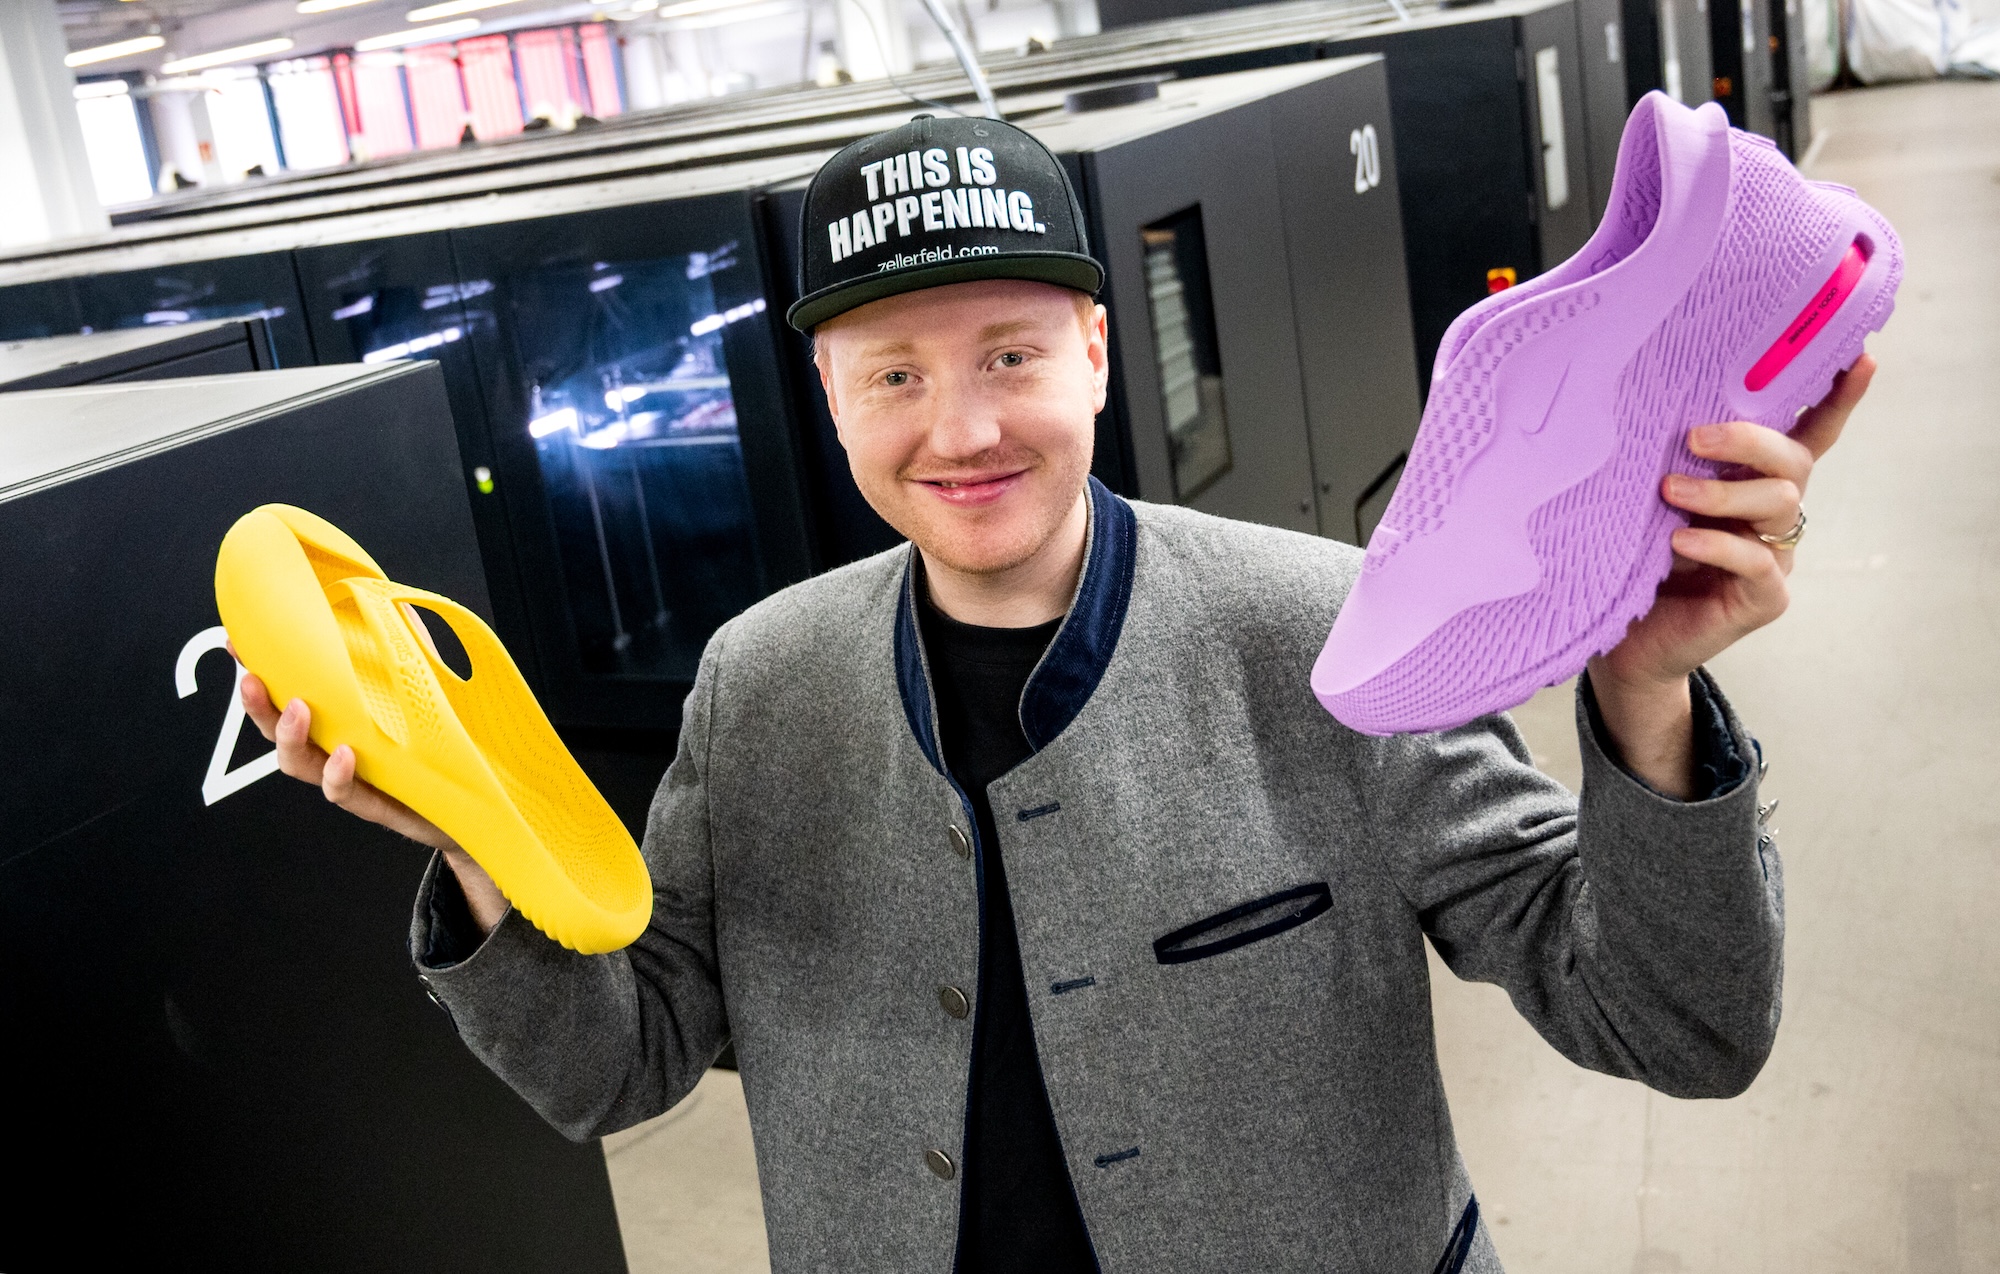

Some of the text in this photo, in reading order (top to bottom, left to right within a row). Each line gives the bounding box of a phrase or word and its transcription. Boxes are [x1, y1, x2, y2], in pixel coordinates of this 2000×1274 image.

[860, 147, 997, 202] THIS IS
[1349, 124, 1381, 194] 20
[828, 187, 1046, 263] HAPPENING.
[877, 244, 999, 273] zellerfeld.com
[1818, 287, 1838, 309] 1000
